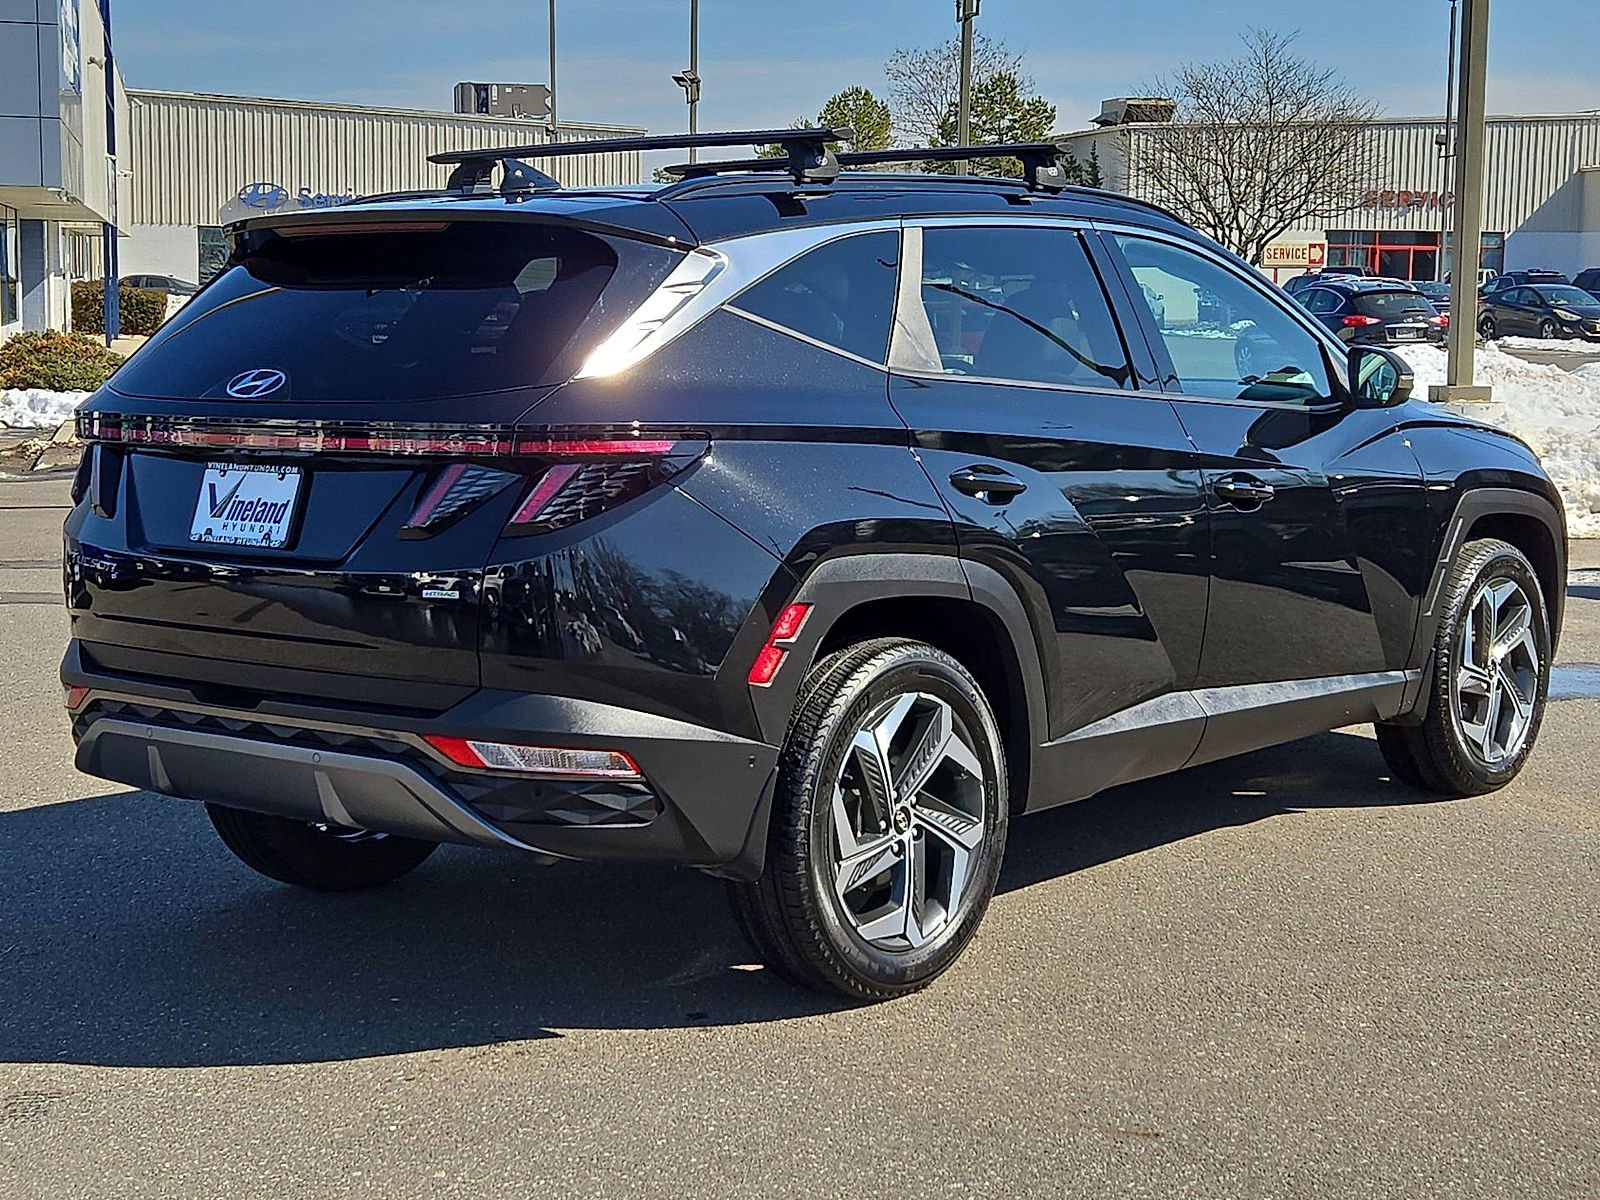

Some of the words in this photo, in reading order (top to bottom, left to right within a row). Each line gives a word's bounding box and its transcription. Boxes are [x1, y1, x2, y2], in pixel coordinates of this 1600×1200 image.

[1266, 247, 1307, 260] SERVICE
[208, 470, 291, 525] Vineland
[221, 521, 281, 535] HYUNDAI
